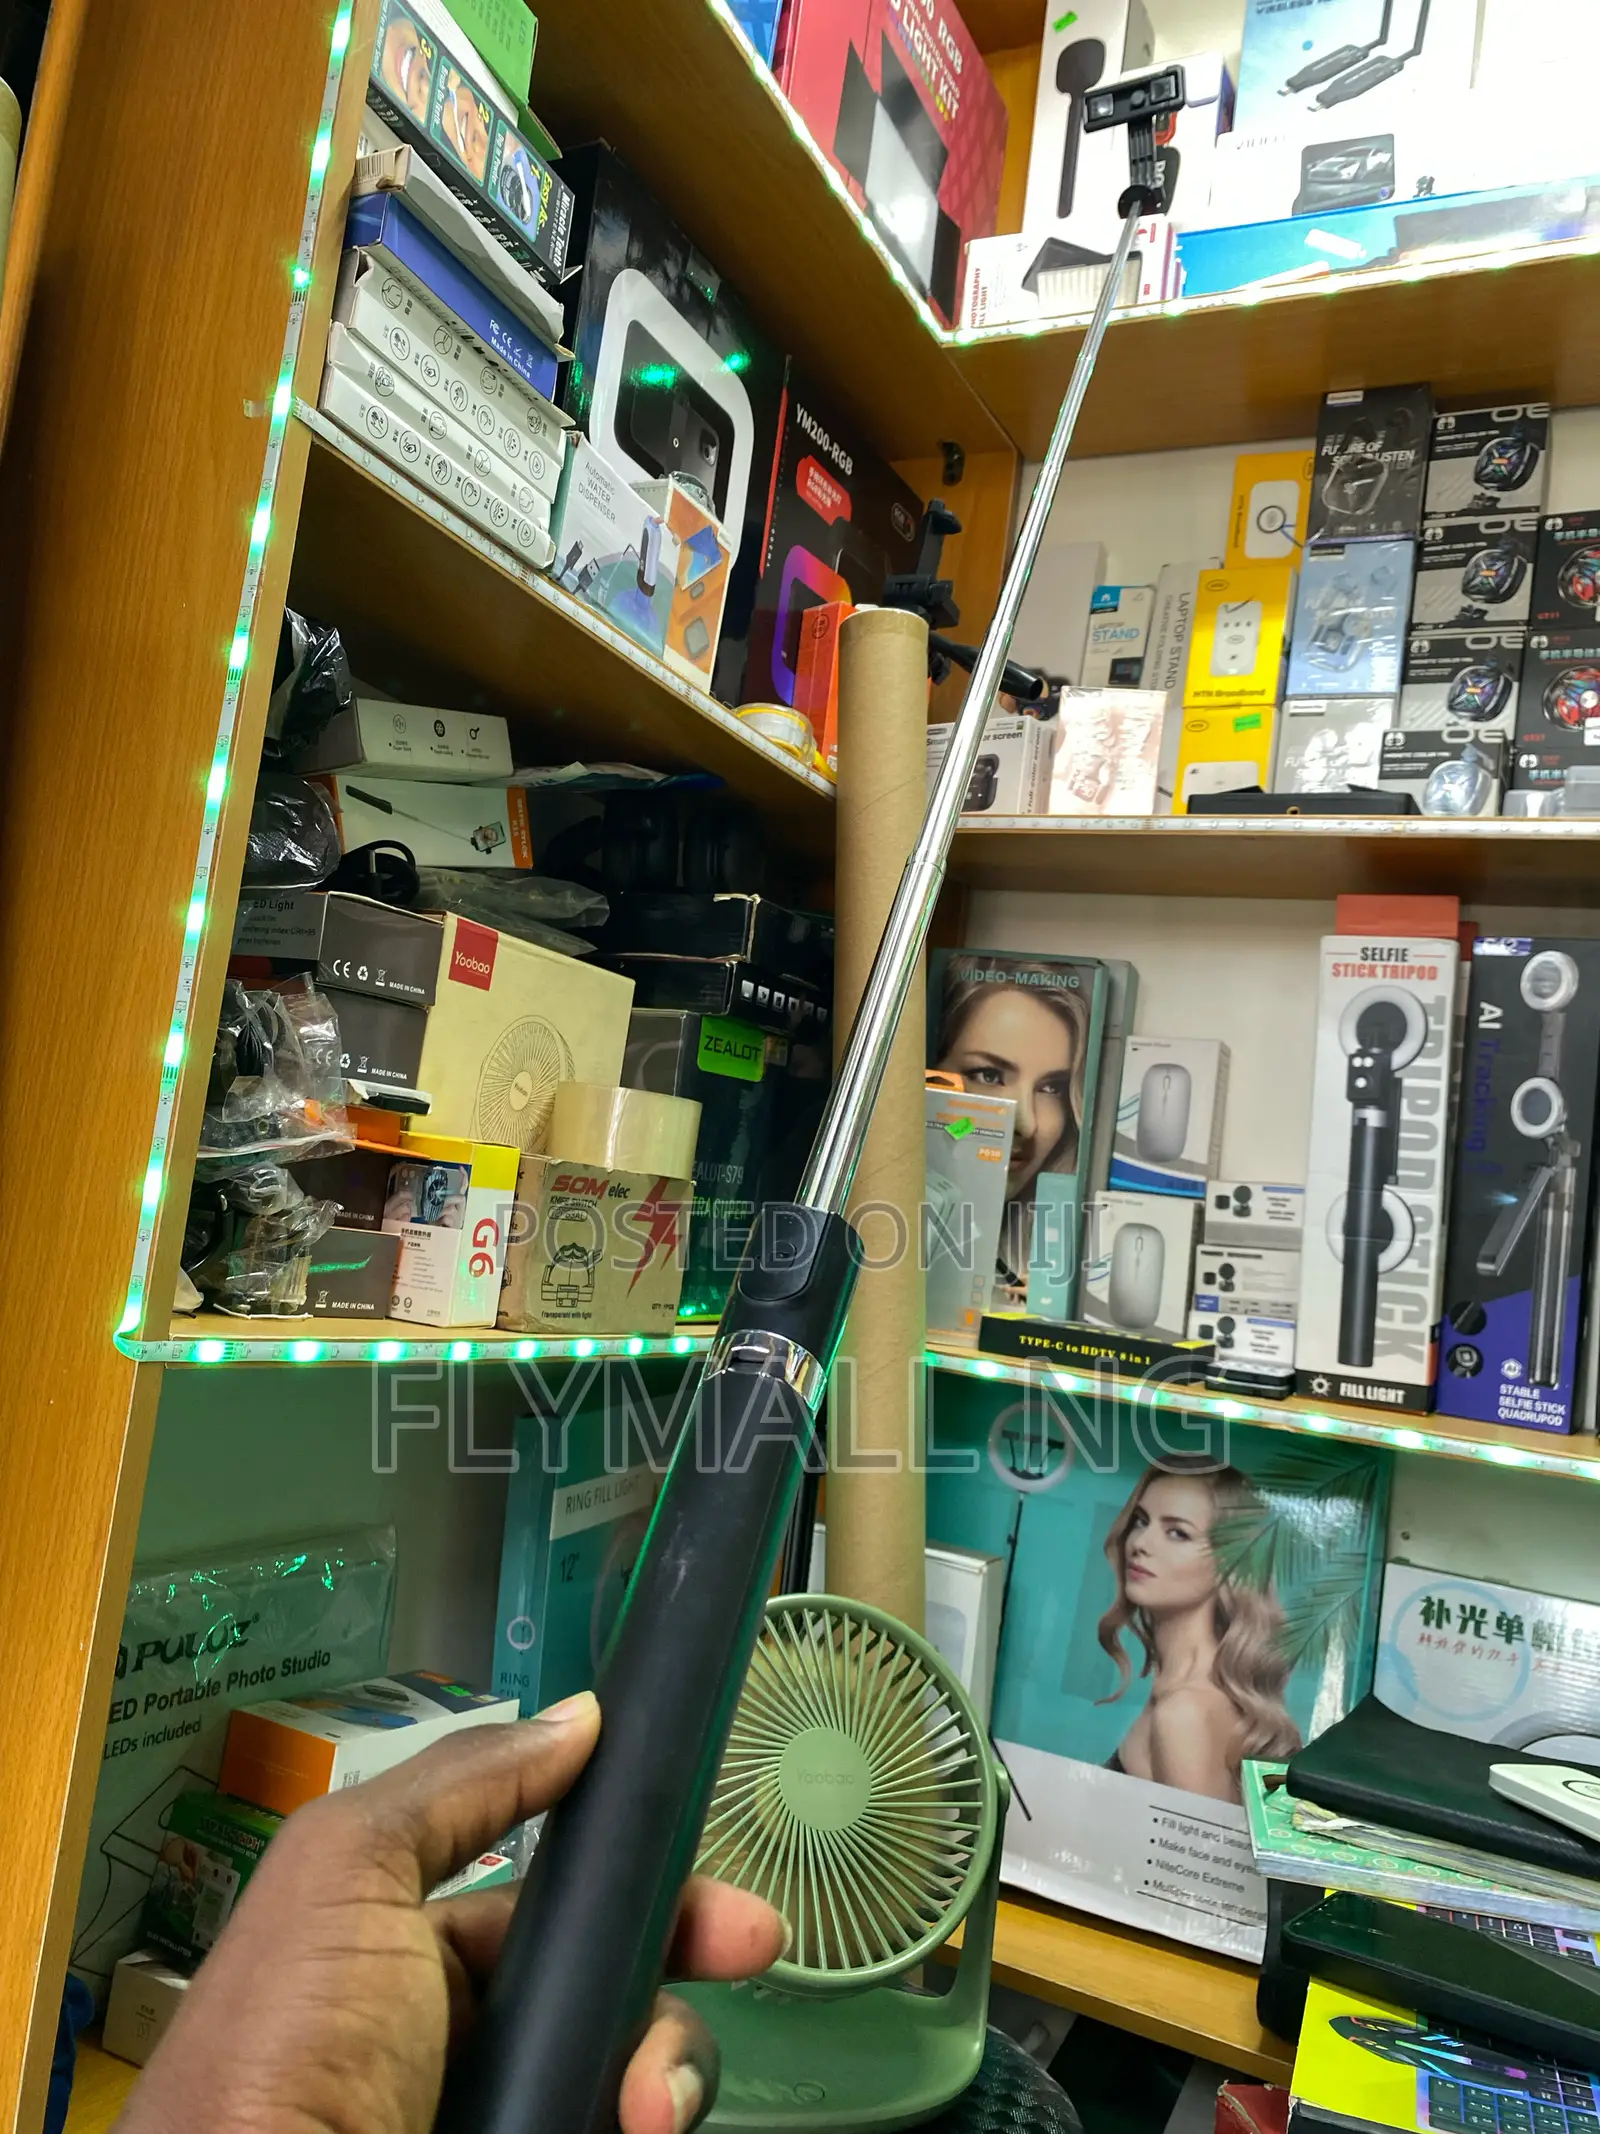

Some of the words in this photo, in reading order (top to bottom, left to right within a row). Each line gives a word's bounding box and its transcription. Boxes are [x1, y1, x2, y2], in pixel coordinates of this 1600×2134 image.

[938, 17, 962, 75] RGB
[902, 5, 939, 83] LIGHT
[940, 76, 959, 119] KIT
[559, 191, 572, 231] Miracle
[552, 232, 566, 267] Teeth
[490, 336, 507, 356] Made
[507, 353, 515, 364] in
[514, 357, 532, 379] China
[796, 403, 853, 476] YM200-RGB
[585, 461, 615, 496] Automatic
[587, 477, 611, 502] WATER
[578, 482, 616, 524] DISPENSER
[1172, 592, 1191, 643] LAPTOP
[1092, 628, 1141, 643] STAND
[1164, 646, 1182, 690] STAND
[269, 900, 295, 912] Light
[455, 951, 490, 975] Yoobao
[1360, 946, 1410, 963] SELFIE
[960, 969, 1080, 988] VIDEO-MAKING
[1332, 962, 1380, 980] STICK
[1381, 963, 1439, 981] TRIPOD
[389, 981, 404, 991] MADE
[404, 984, 410, 992] IN
[410, 985, 425, 995] CHINA
[1477, 1001, 1504, 1030] AI
[703, 1034, 763, 1063] ZEALOT
[371, 1067, 386, 1077] MADE
[392, 1070, 408, 1081] CHINA
[1396, 995, 1447, 1193] TRIPOD
[1465, 1038, 1501, 1152] Tracking
[550, 1174, 610, 1199] SOM
[608, 1182, 631, 1199] elec
[357, 1213, 374, 1221] CHINA
[469, 1218, 499, 1278] G6
[1374, 1203, 1435, 1366] STICK
[331, 1301, 350, 1310] MADE
[350, 1302, 357, 1310] IN
[357, 1303, 375, 1311] CHINA
[1019, 1335, 1064, 1351] TYPE-C
[1066, 1344, 1079, 1353] to
[1080, 1345, 1117, 1359] HDTV
[1128, 1354, 1142, 1364] in
[1340, 1383, 1365, 1400] FILL
[1366, 1385, 1407, 1404] LIGHT
[1499, 1396, 1534, 1411] SELFIE
[1535, 1401, 1567, 1415] STICK
[1500, 1384, 1541, 1400] STABLE
[1498, 1407, 1564, 1427] QUADRUPOD
[565, 1488, 592, 1515] RING
[593, 1484, 613, 1508] FILL
[613, 1474, 642, 1501] LIGHT
[108, 1698, 137, 1725] ED
[144, 1678, 221, 1716] Portable
[226, 1665, 276, 1693] Photo
[281, 1649, 331, 1678] Studio
[500, 1671, 530, 1688] RING
[103, 1736, 138, 1761] LEDs
[142, 1719, 201, 1747] included
[797, 1766, 856, 1785] Yoobao
[1161, 1817, 1177, 1829] Fill
[1178, 1821, 1199, 1836] light
[1201, 1830, 1220, 1842] and
[1158, 1838, 1186, 1854] Make
[1188, 1846, 1210, 1861] face
[1212, 1855, 1232, 1867] and
[1155, 1859, 1200, 1880] NiteCore
[1202, 1872, 1245, 1893] Extreme
